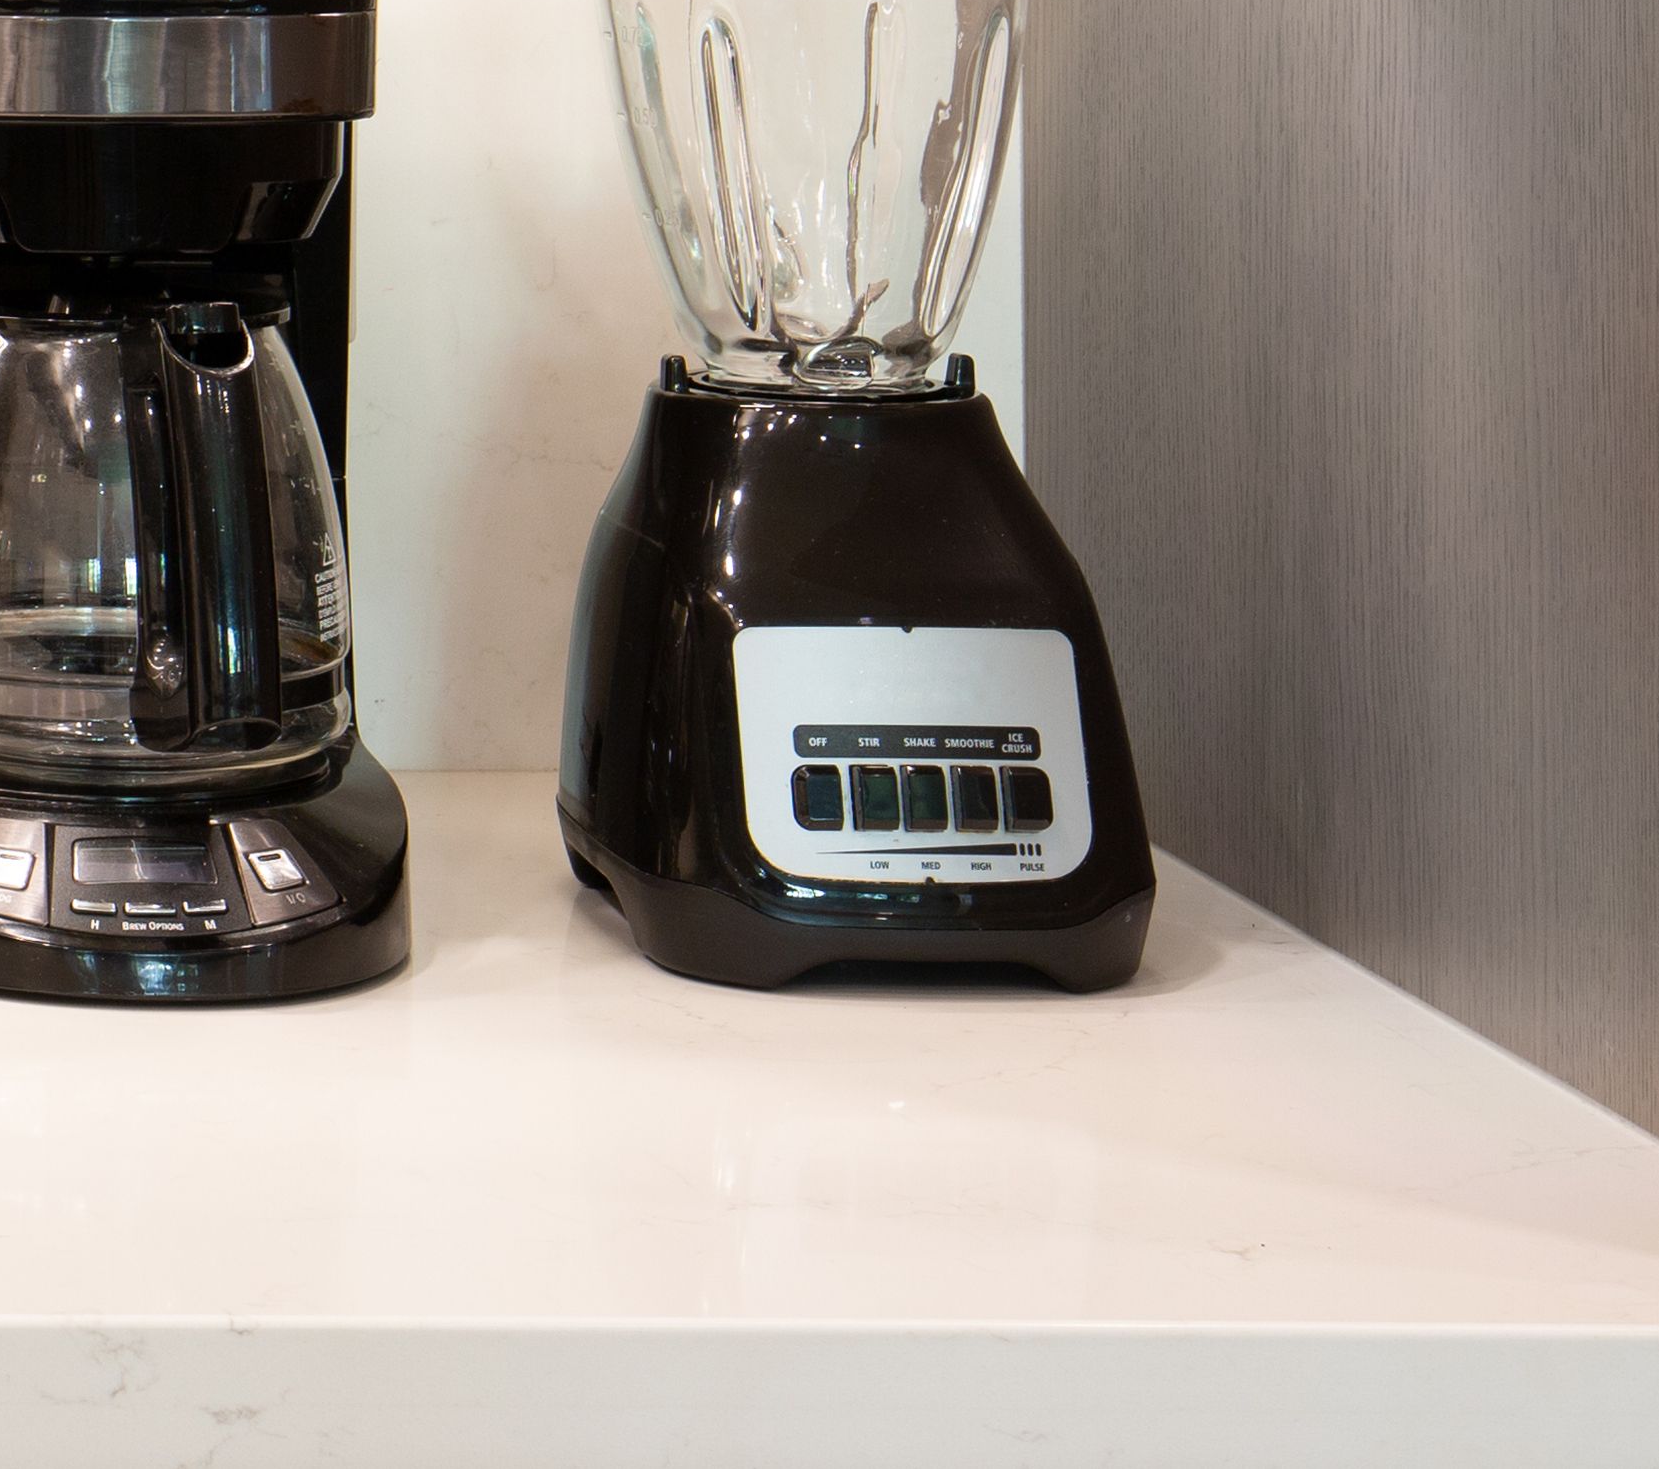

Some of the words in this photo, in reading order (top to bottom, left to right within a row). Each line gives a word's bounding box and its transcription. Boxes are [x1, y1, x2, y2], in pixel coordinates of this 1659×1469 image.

[808, 737, 828, 747] OFF
[858, 737, 880, 747] STIR
[903, 737, 936, 747] SHAKE
[1008, 733, 1024, 743] ICE
[944, 738, 995, 749] SMOOTHIE
[1001, 743, 1032, 753] CRUSH
[870, 860, 890, 870] LOW
[921, 861, 941, 870] MED
[970, 862, 992, 871] HIGH
[1019, 862, 1045, 872] PULSE
[90, 919, 100, 930] H
[204, 919, 217, 930] M
